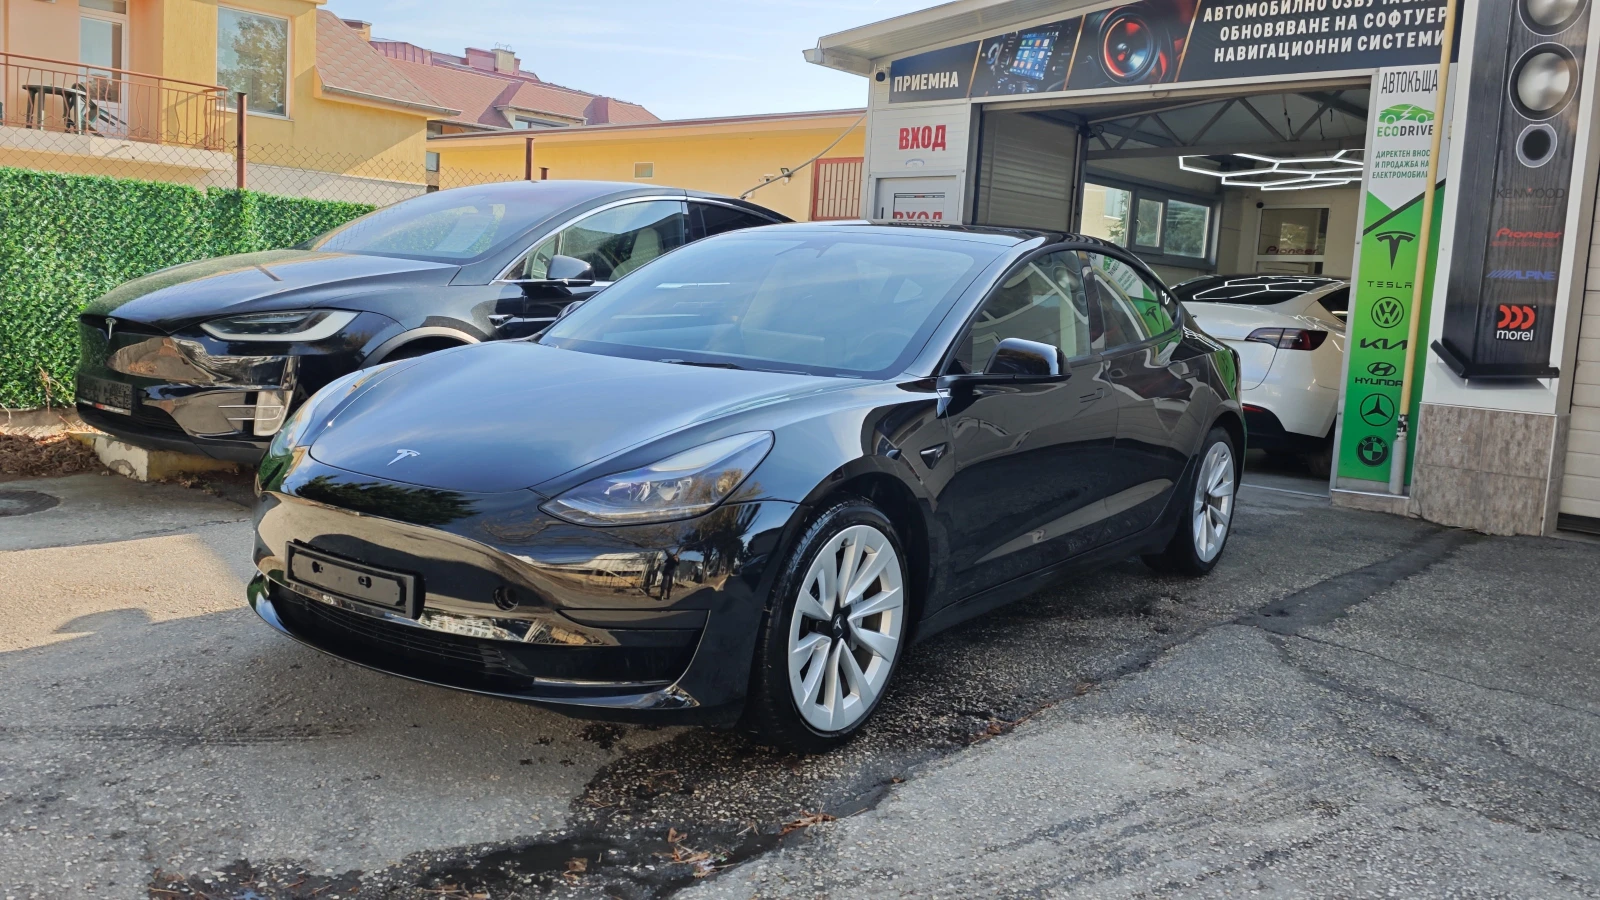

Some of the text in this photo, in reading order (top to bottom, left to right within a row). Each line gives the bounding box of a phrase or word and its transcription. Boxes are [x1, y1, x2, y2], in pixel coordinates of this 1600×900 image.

[1203, 0, 1327, 22] АВТОМОБИЛНО
[1220, 6, 1447, 41] ОБНОВЯВАНЕ НА СОФТУЕР
[1214, 29, 1445, 62] НАВИГАЦИОННИ СИСТЕМИ
[893, 71, 959, 93] ПРИЕМНА
[1381, 69, 1438, 94] АВТОКЪЩА
[1377, 125, 1434, 137] ECODRIVE
[898, 124, 946, 151] ВХОД
[1376, 149, 1431, 159] ДИРЕКТЕН ВНОС
[1381, 160, 1419, 169] ПРОДАЖБА
[1496, 187, 1565, 199] KENWOOD
[1495, 227, 1562, 239] Pioneer
[1265, 245, 1319, 255] Pioneer
[1508, 270, 1556, 280] ALPINE
[1367, 280, 1412, 289] TESLA
[1496, 329, 1534, 341] morel
[1354, 377, 1404, 388] HYUNDA
